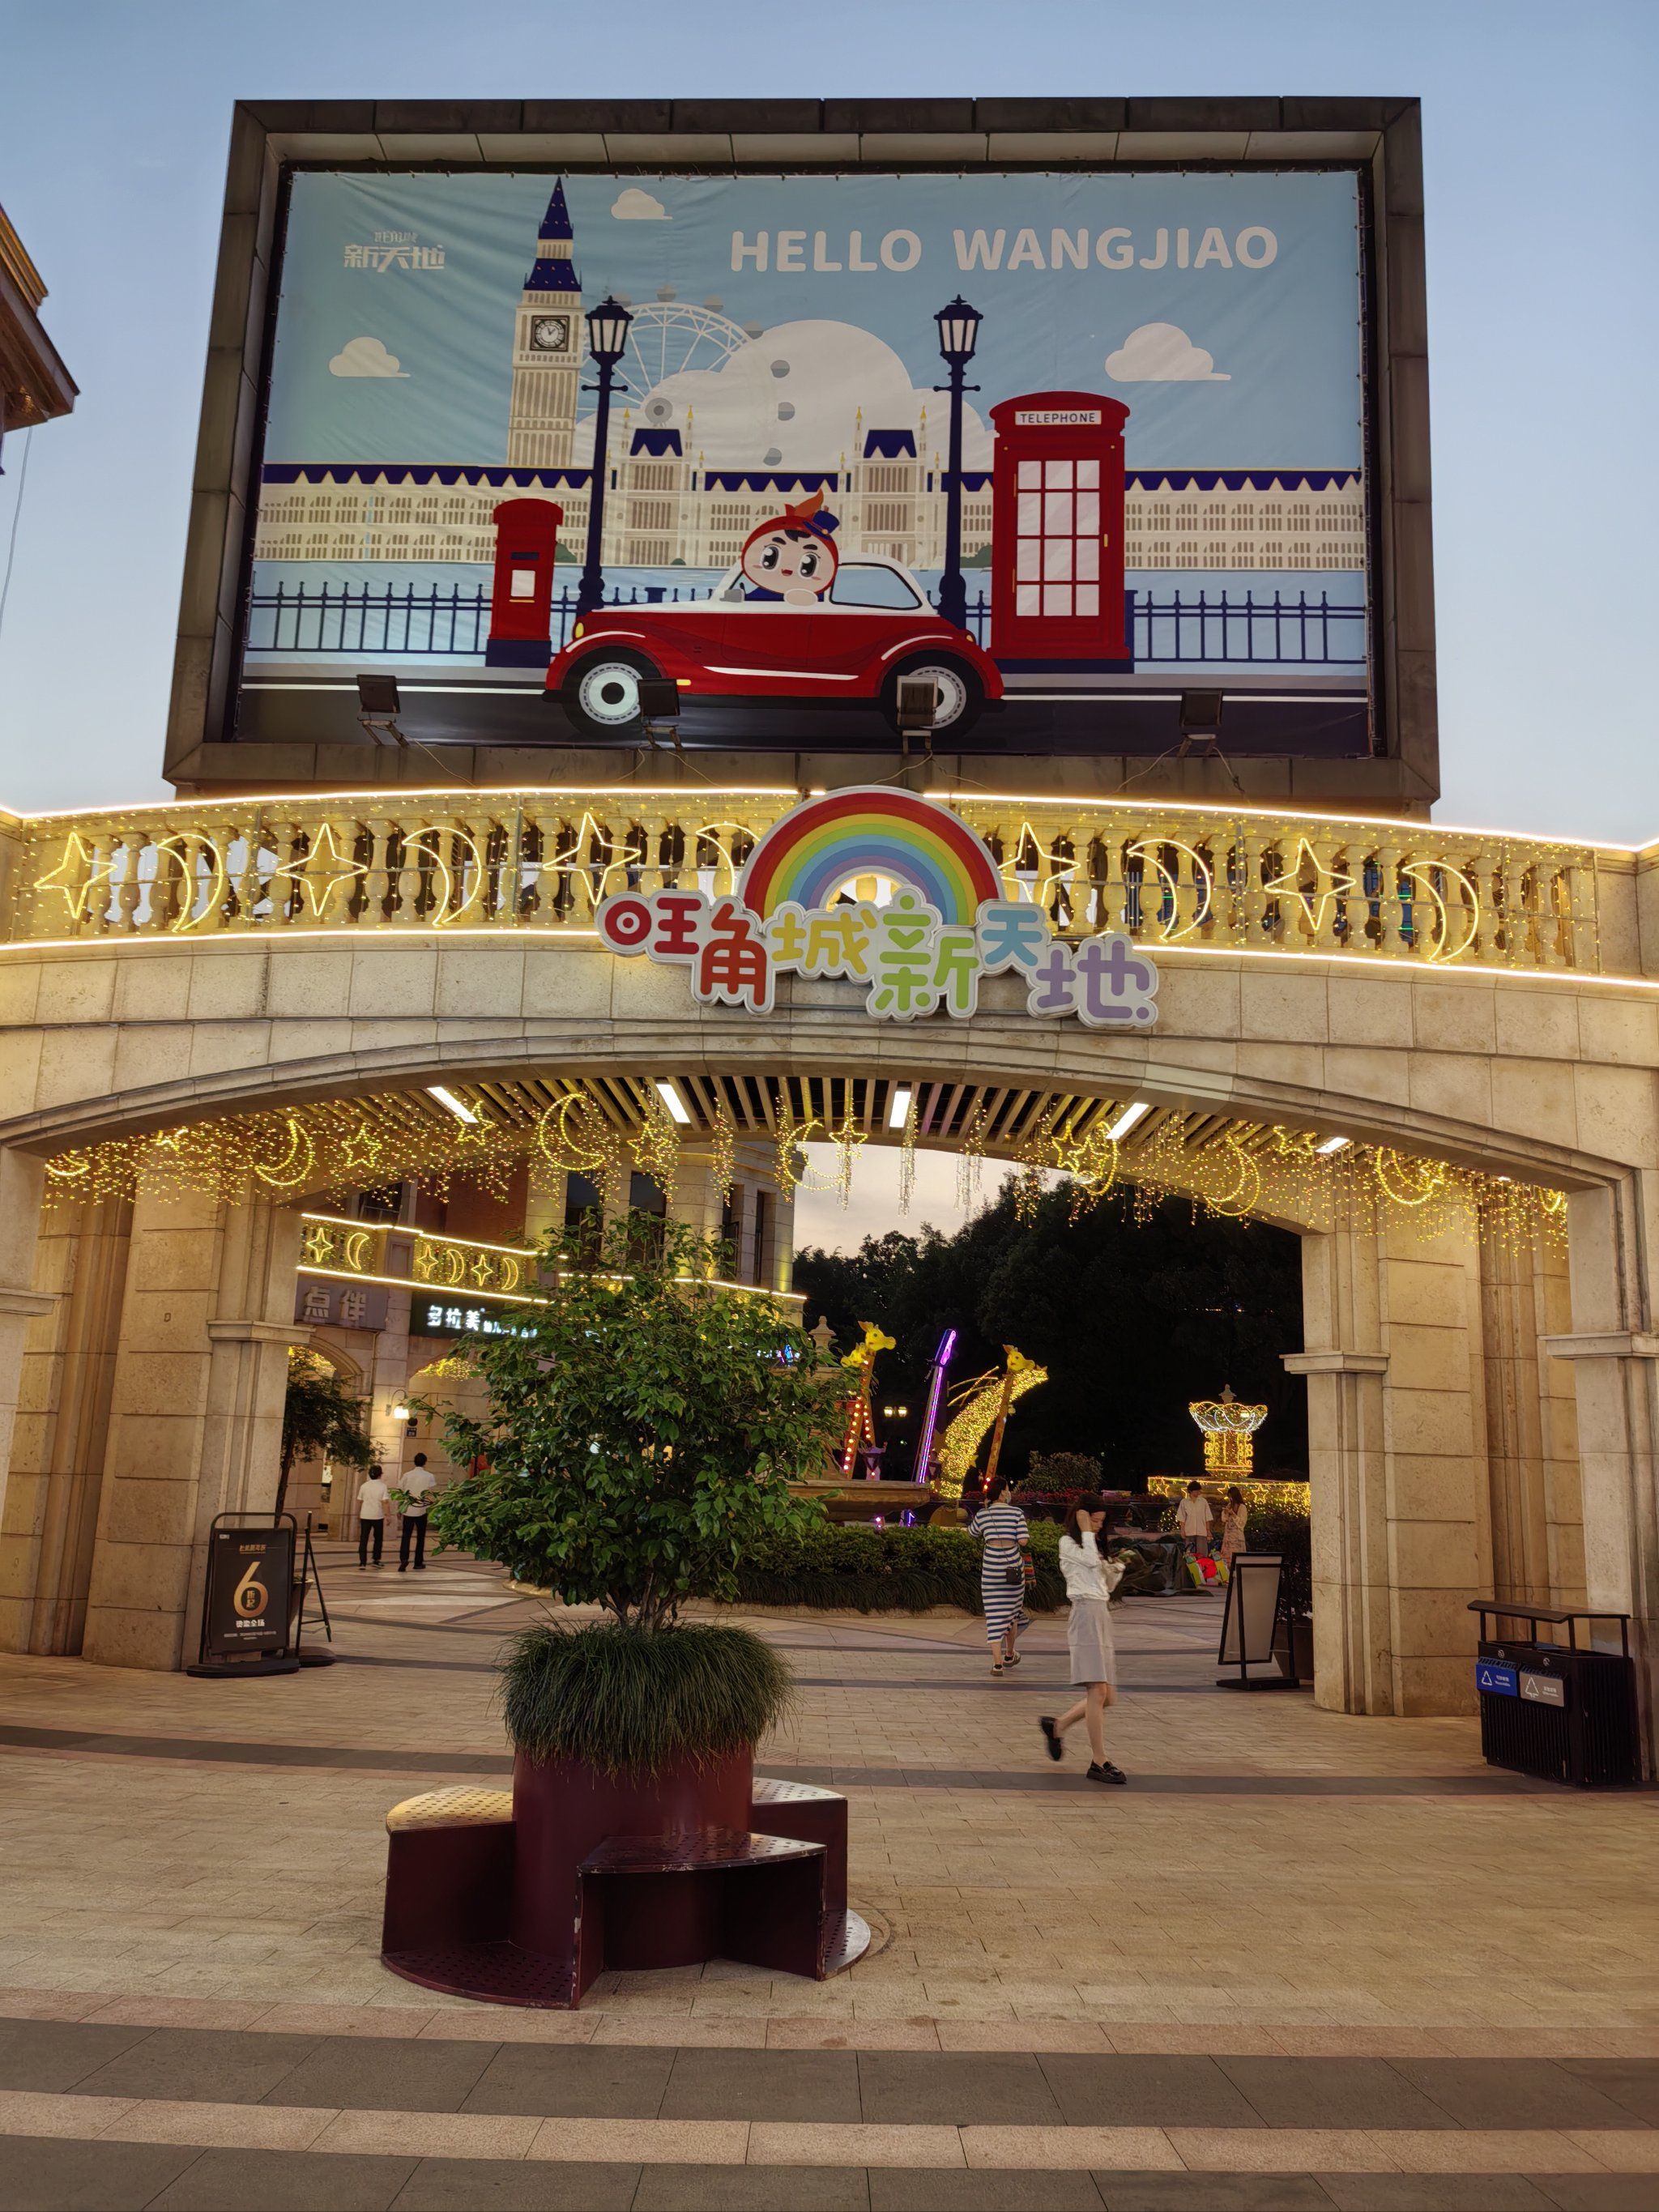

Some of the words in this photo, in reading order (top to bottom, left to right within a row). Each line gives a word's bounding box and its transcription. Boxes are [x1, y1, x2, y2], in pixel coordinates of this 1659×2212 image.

[343, 244, 446, 273] 新天地
[730, 228, 923, 273] HELLO
[952, 225, 1279, 271] WANGJIAO
[1021, 412, 1096, 424] TELEPHONE
[603, 894, 1152, 1021] 旺角城新天地
[233, 1561, 269, 1618] 6
